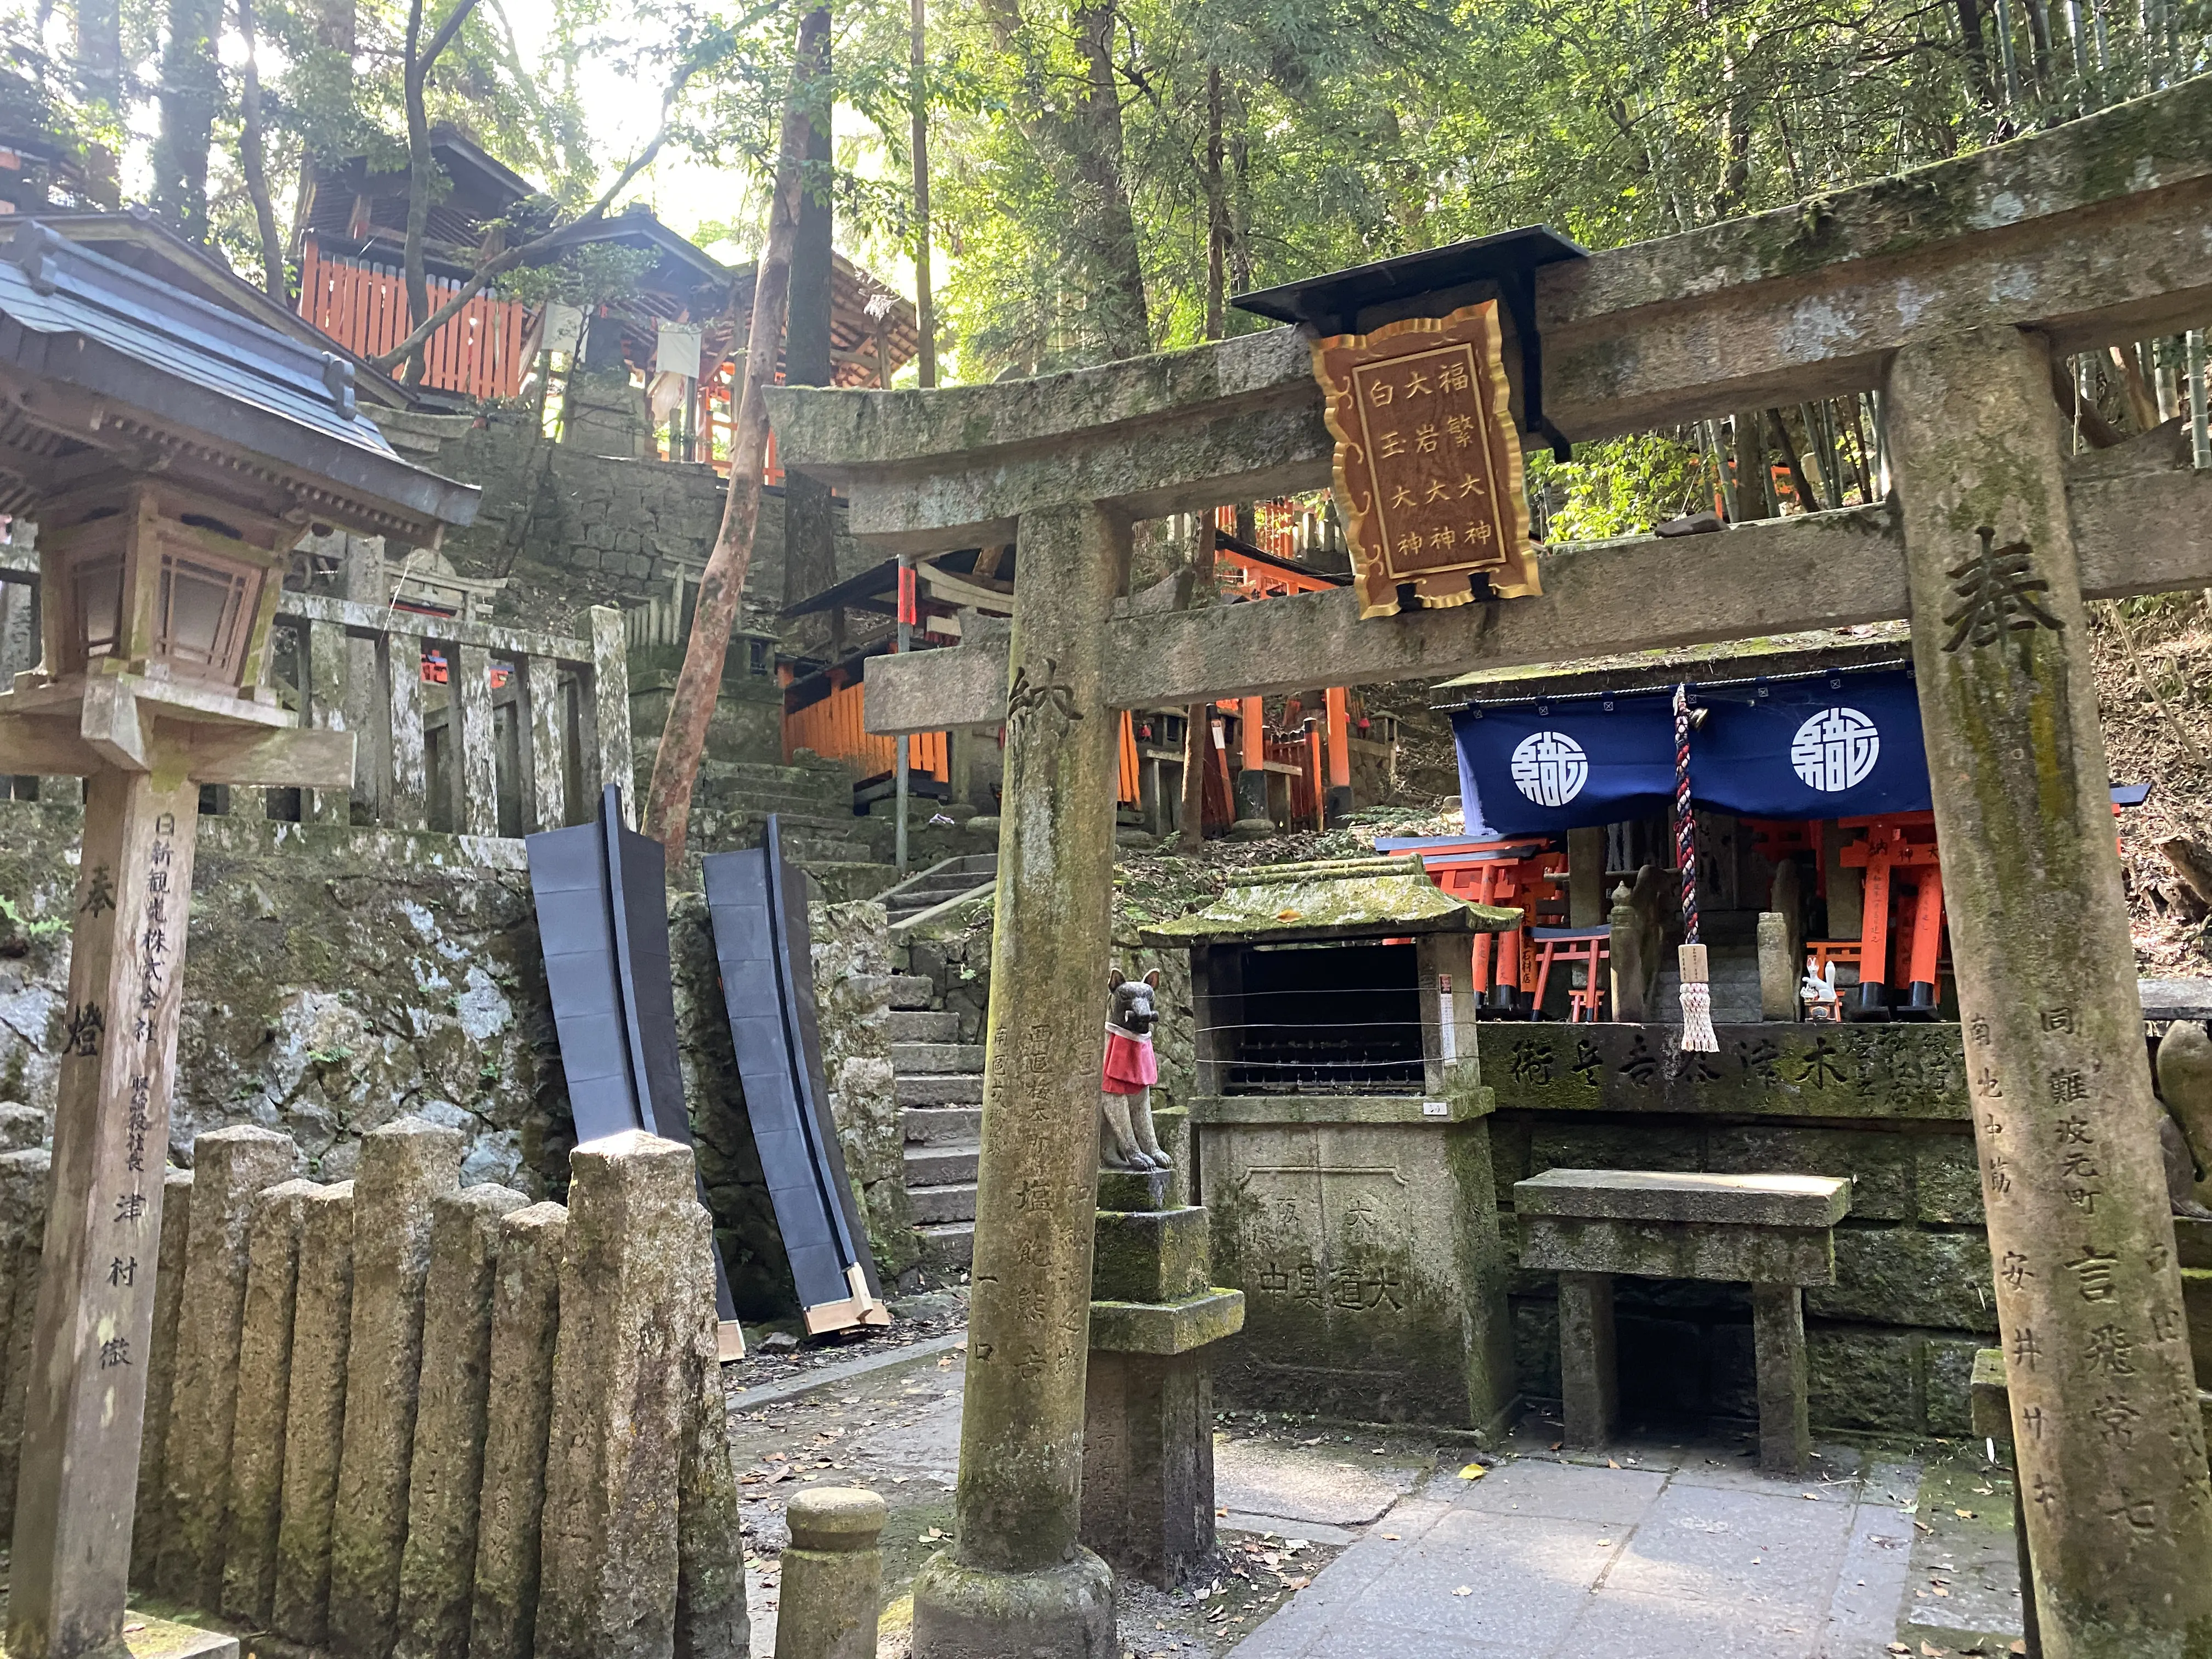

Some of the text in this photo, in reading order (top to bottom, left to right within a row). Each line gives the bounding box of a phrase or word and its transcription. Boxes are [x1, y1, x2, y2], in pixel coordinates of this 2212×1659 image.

[1371, 378, 1424, 556] 白玉大神
[1404, 370, 1457, 551] 大岩大神
[1438, 362, 1492, 546] 福繁大神
[1940, 526, 2067, 653] 奉
